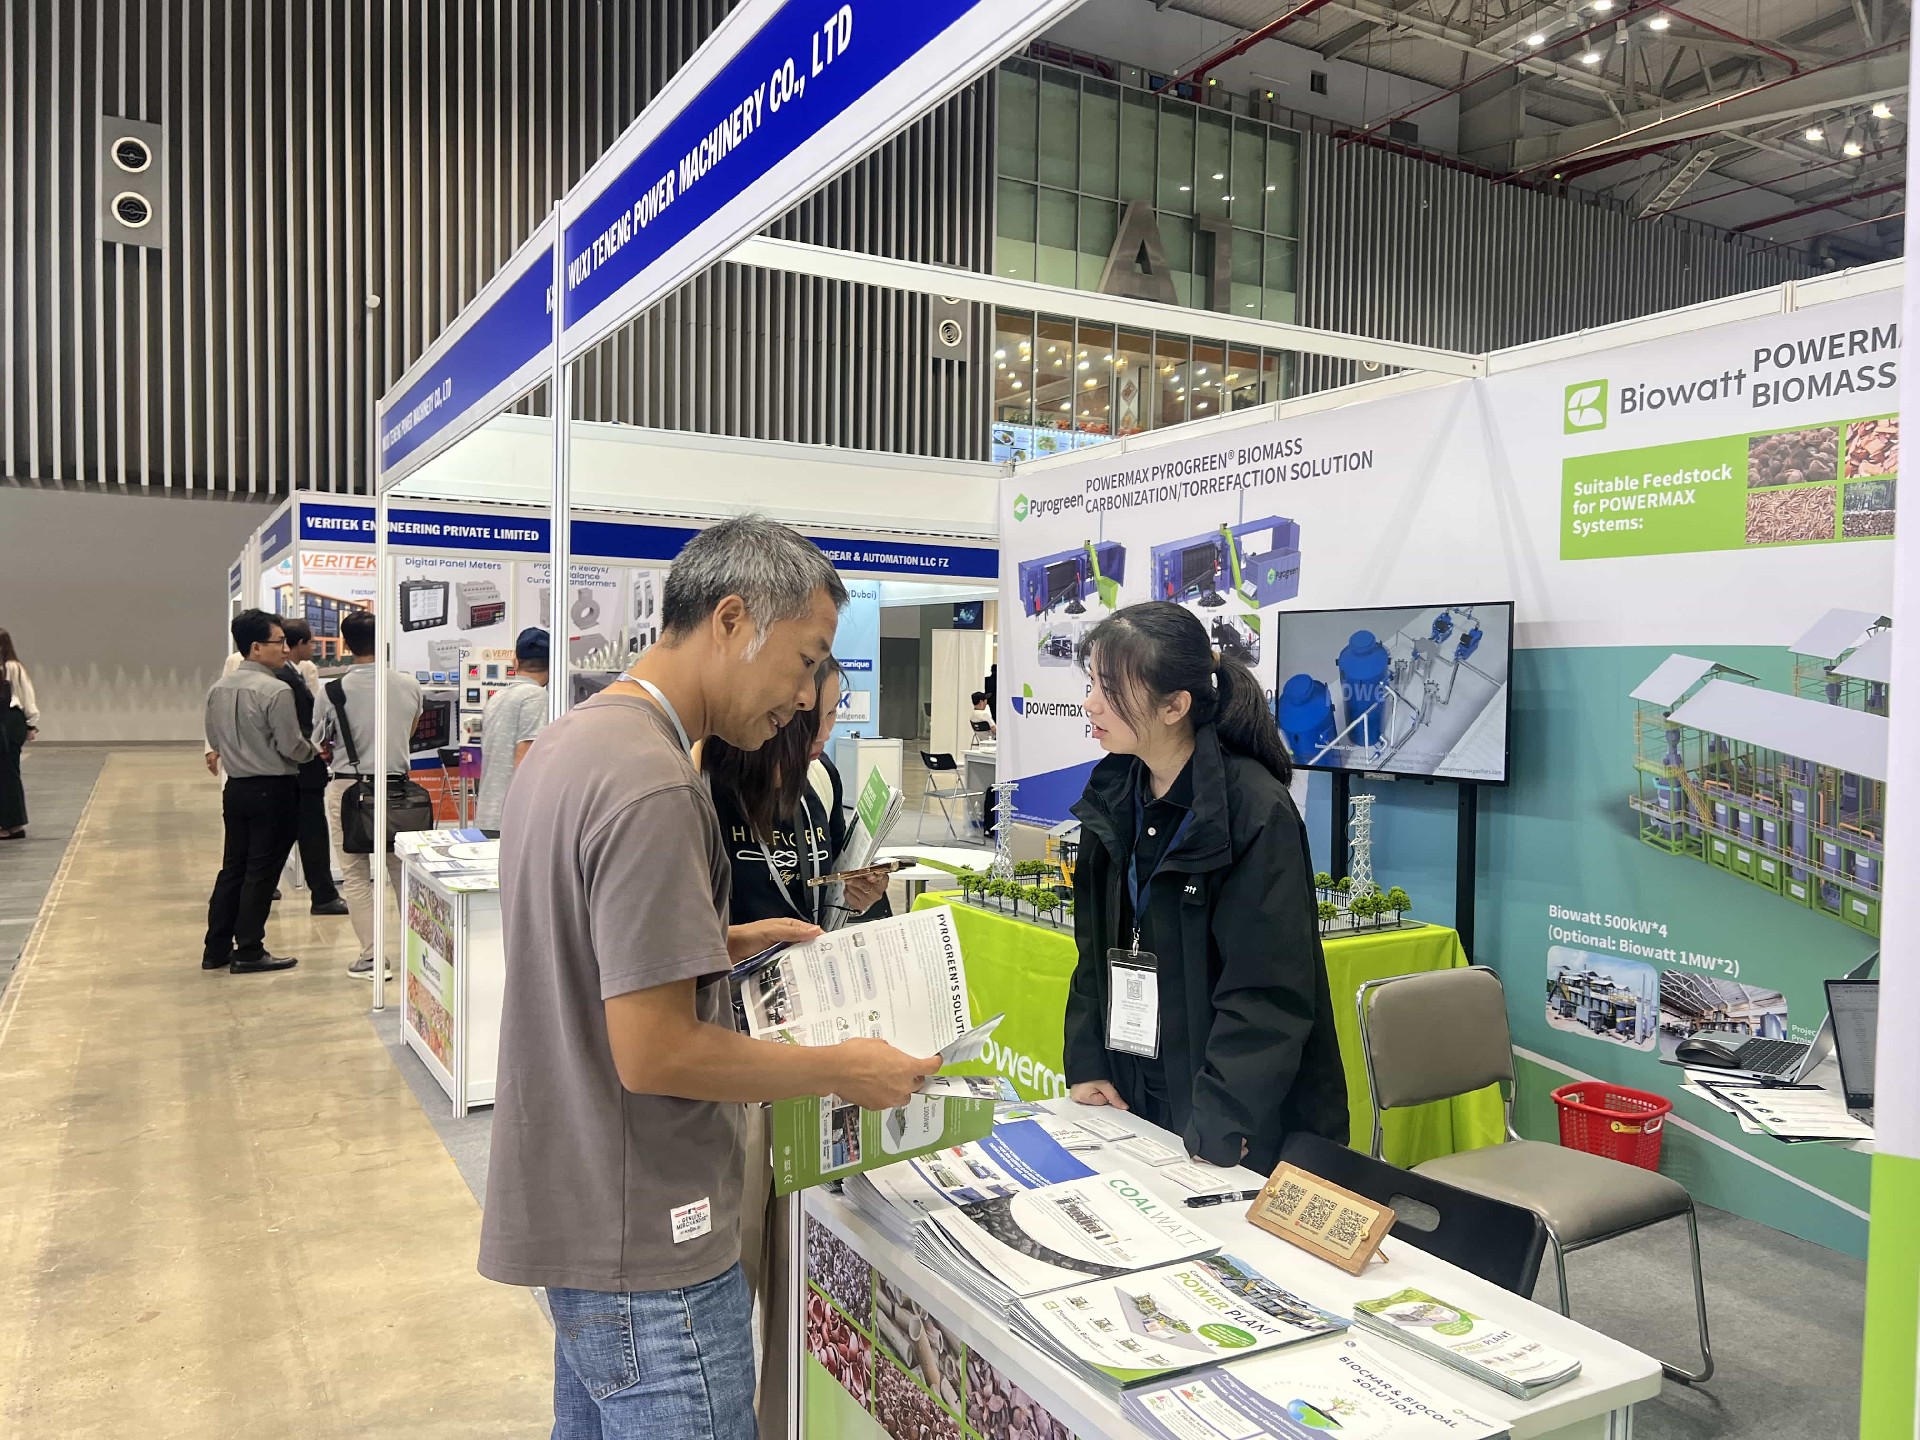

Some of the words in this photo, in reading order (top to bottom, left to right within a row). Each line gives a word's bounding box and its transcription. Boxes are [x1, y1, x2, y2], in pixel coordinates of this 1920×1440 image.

[568, 246, 591, 292] WUXI
[592, 209, 632, 271] TENENG
[633, 169, 675, 236] POWER
[678, 82, 765, 196] MACHINERY
[769, 57, 805, 113] CO.,
[812, 4, 853, 79] LTD
[1753, 323, 1902, 373] POWERM
[443, 377, 452, 402] LTD
[1620, 368, 1747, 414] Biowatt
[1752, 362, 1897, 409] BIOMASS
[1085, 468, 1150, 494] POWERMAX
[1238, 437, 1303, 465] BIOMASS
[1573, 470, 1639, 497] Suitable
[1642, 463, 1733, 489] Feedstock
[1085, 467, 1287, 514] CARBONIZATION/TORREFACTION
[1291, 449, 1374, 481] SOLUTION
[1030, 493, 1084, 518] Pyrogreen
[1573, 498, 1596, 516] for
[1599, 489, 1696, 514] POWERMAX
[306, 516, 359, 531] VERITEK
[362, 520, 440, 536] ENINEERING
[443, 526, 491, 540] PRIVATE
[494, 528, 540, 541] LIMITED
[1572, 516, 1644, 538] Systems:
[301, 553, 377, 569] VERITEK
[405, 557, 437, 569] Digital
[439, 559, 467, 569] Panel
[469, 561, 502, 570] Meters
[822, 550, 852, 562] HGEAR
[853, 551, 861, 561] &
[862, 553, 918, 566] AUTOMATION
[920, 557, 937, 567] LLC
[938, 558, 950, 568] FZ
[1275, 566, 1299, 582] Pyrogreen
[570, 579, 617, 587] ansformers
[492, 649, 516, 657] VERIT
[1025, 701, 1083, 719] powermax
[1549, 904, 1602, 926] Biowatt
[937, 913, 961, 992] PYROGREEN'S
[1548, 924, 1617, 951] (Optional:
[1619, 939, 1677, 964] Biowatt
[972, 1037, 1067, 1100] owerm
[1109, 1179, 1207, 1245] COALWATT
[1173, 1272, 1231, 1311] POWER
[1224, 1309, 1281, 1335] PLANT
[1483, 1330, 1512, 1346] PLANT
[1338, 1356, 1392, 1390] BIOCHAR
[1391, 1388, 1402, 1396] &
[1402, 1396, 1460, 1429] BIOCOAL
[1352, 1377, 1418, 1416] SOLUTION
